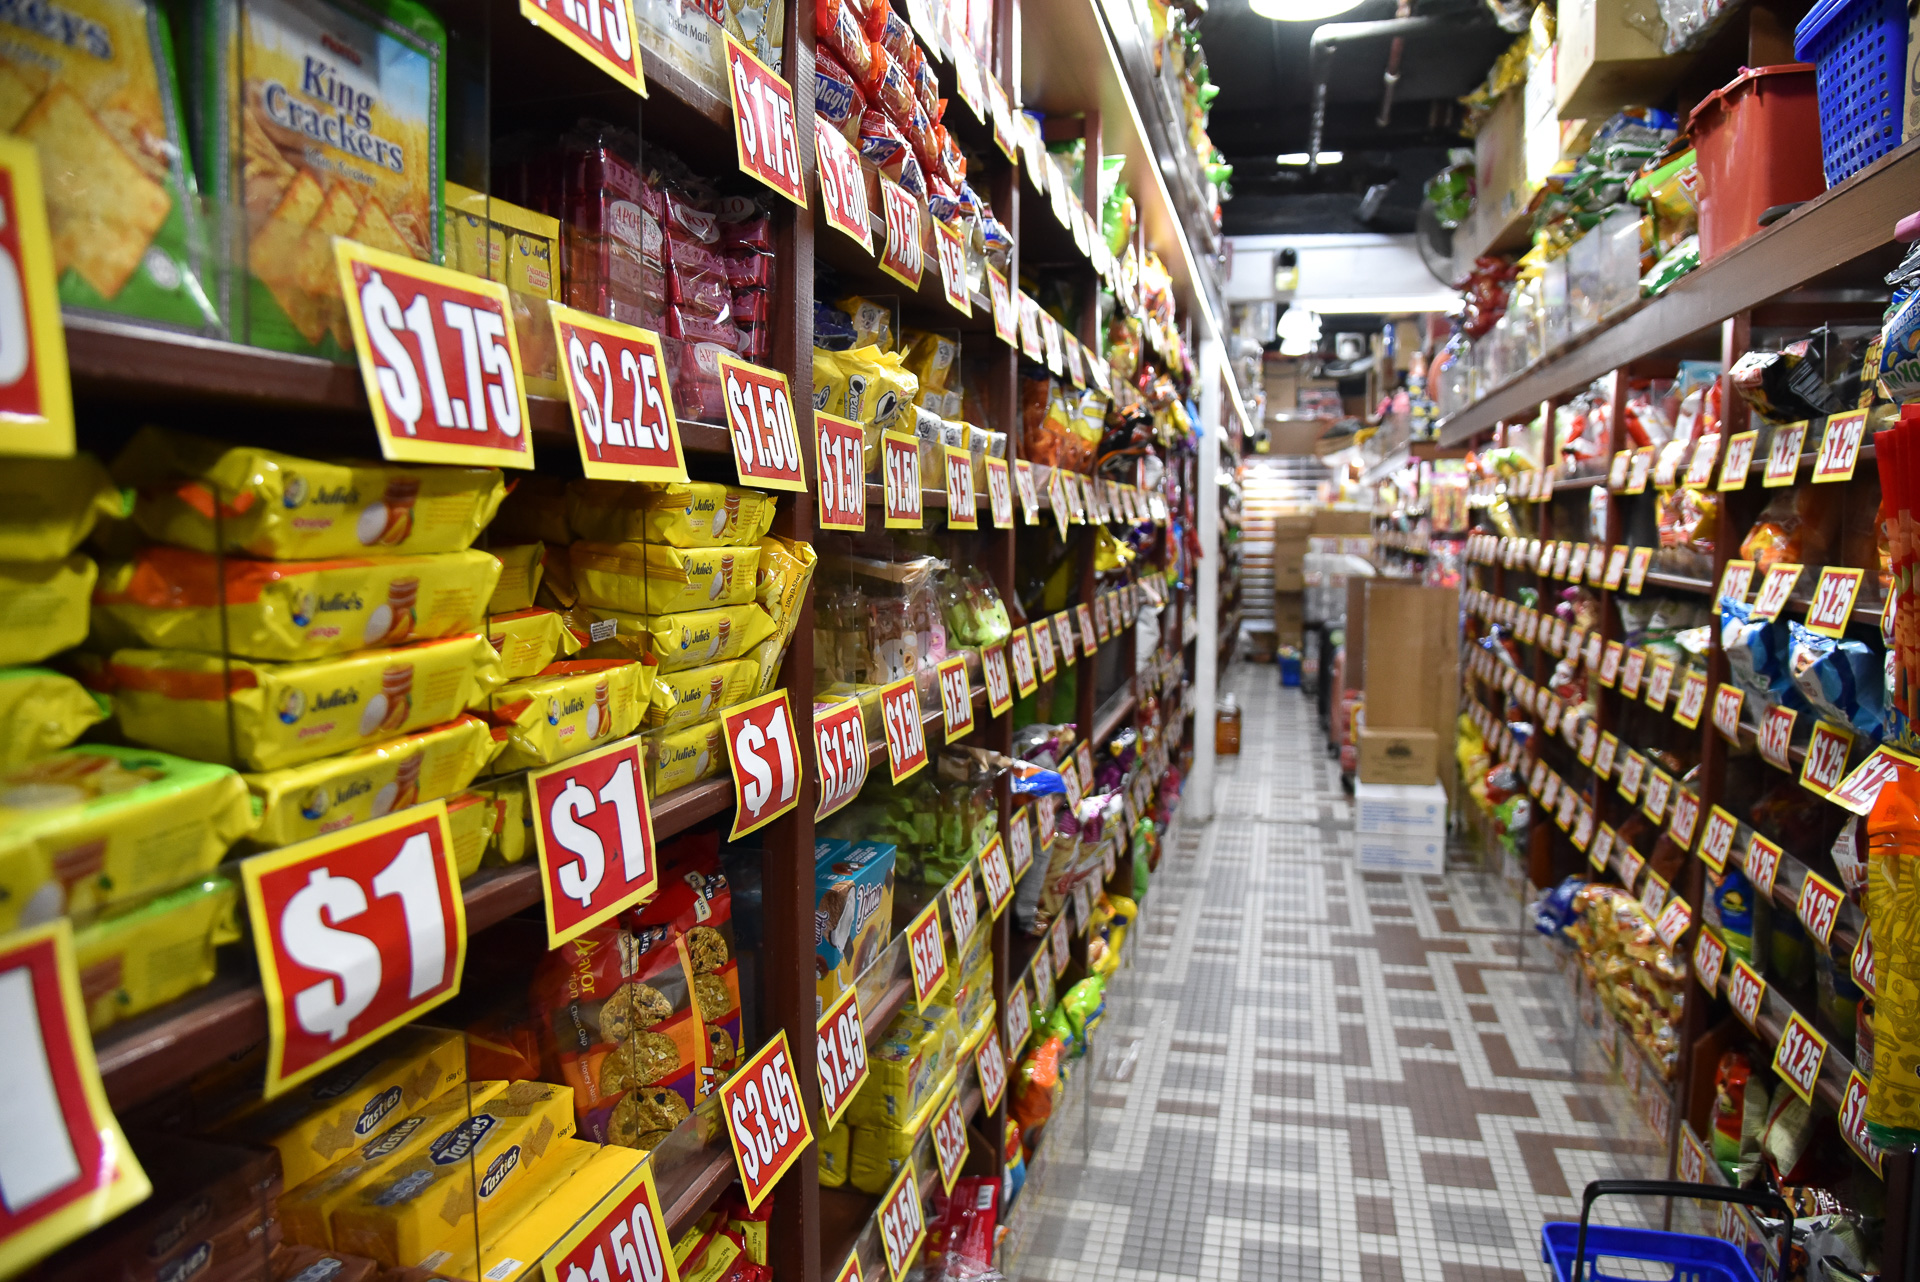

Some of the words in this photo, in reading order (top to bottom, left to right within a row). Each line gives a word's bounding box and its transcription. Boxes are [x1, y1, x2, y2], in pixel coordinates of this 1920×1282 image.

[304, 55, 374, 129] King
[734, 53, 800, 187] $1.75
[264, 83, 404, 172] Crackers
[887, 185, 921, 275] $1.50
[361, 270, 522, 438] $1.75
[568, 329, 670, 459] $2.25
[727, 370, 798, 473] $1.50
[820, 424, 863, 517] $1.50
[886, 443, 920, 517] $1.50
[1770, 429, 1804, 477] $1.25
[1819, 420, 1863, 474] $1.25
[695, 498, 716, 512] Julie's
[948, 456, 974, 519] $1.50
[693, 563, 713, 576] Julie's
[1811, 573, 1856, 625] $1.25
[691, 627, 711, 644] Julie's
[561, 695, 585, 718] Julie's
[681, 688, 702, 704] Julie's
[886, 688, 924, 771] $1.50
[942, 667, 971, 733] $1.50
[672, 745, 697, 762] Julie's
[735, 705, 795, 818] $1
[820, 716, 867, 810] $1.50
[1804, 731, 1849, 788] $1.25
[550, 758, 647, 909] $1
[280, 830, 446, 1043] $1
[1799, 879, 1836, 947] $1.25
[914, 918, 943, 995] $1.50
[570, 1005, 583, 1031] Choco
[577, 1027, 588, 1047] Chip
[816, 1003, 865, 1112] $1.95
[1777, 1022, 1821, 1093] $1.25
[360, 1090, 399, 1133] Tasties
[580, 1060, 593, 1087] Honey
[587, 1084, 598, 1104] Nuts
[369, 1117, 421, 1157] Tasties
[438, 1117, 490, 1161] Tasties
[732, 1051, 801, 1187] $3.95
[483, 1150, 517, 1194] Tasties
[883, 1177, 920, 1275] $1.50
